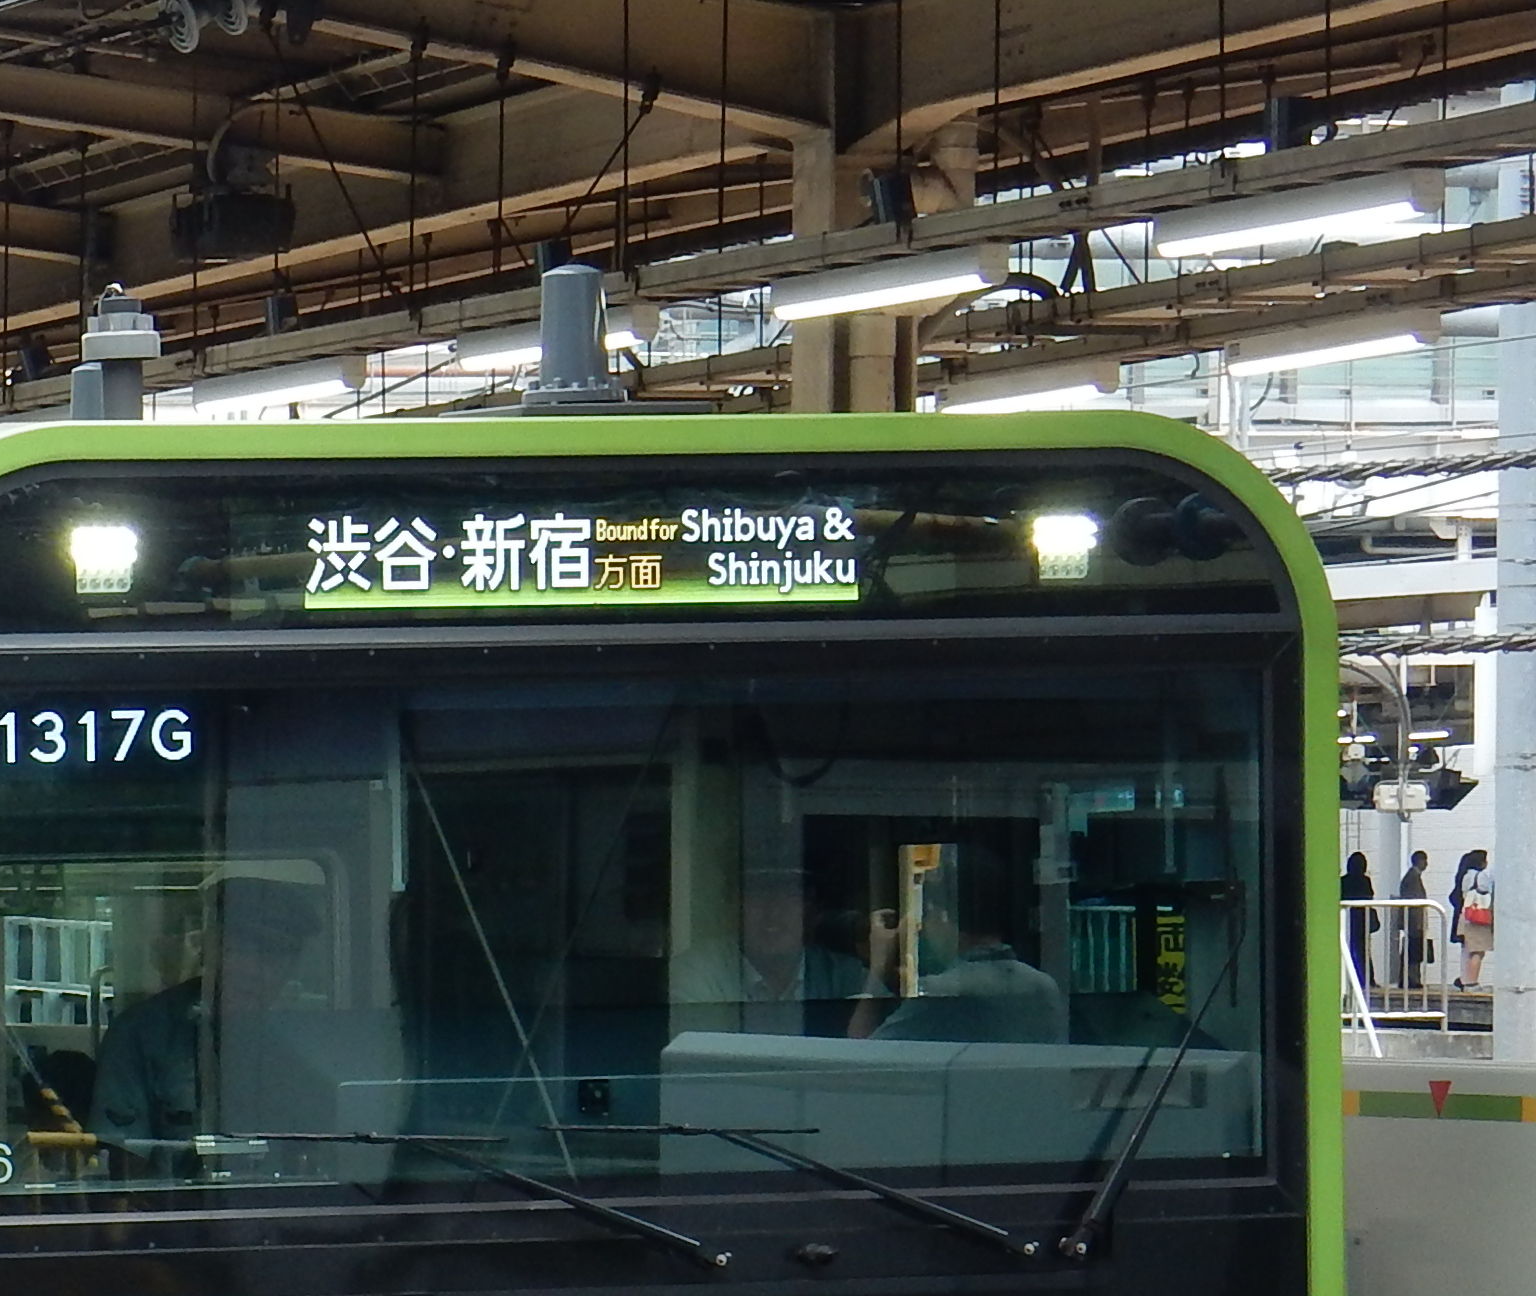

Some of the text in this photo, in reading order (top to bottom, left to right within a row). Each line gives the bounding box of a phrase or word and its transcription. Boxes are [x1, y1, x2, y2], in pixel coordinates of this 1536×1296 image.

[680, 507, 856, 550] Shibuya &
[305, 512, 592, 594] 渋谷・新宿
[594, 553, 663, 590] 方面
[707, 550, 856, 594] Shinjuku
